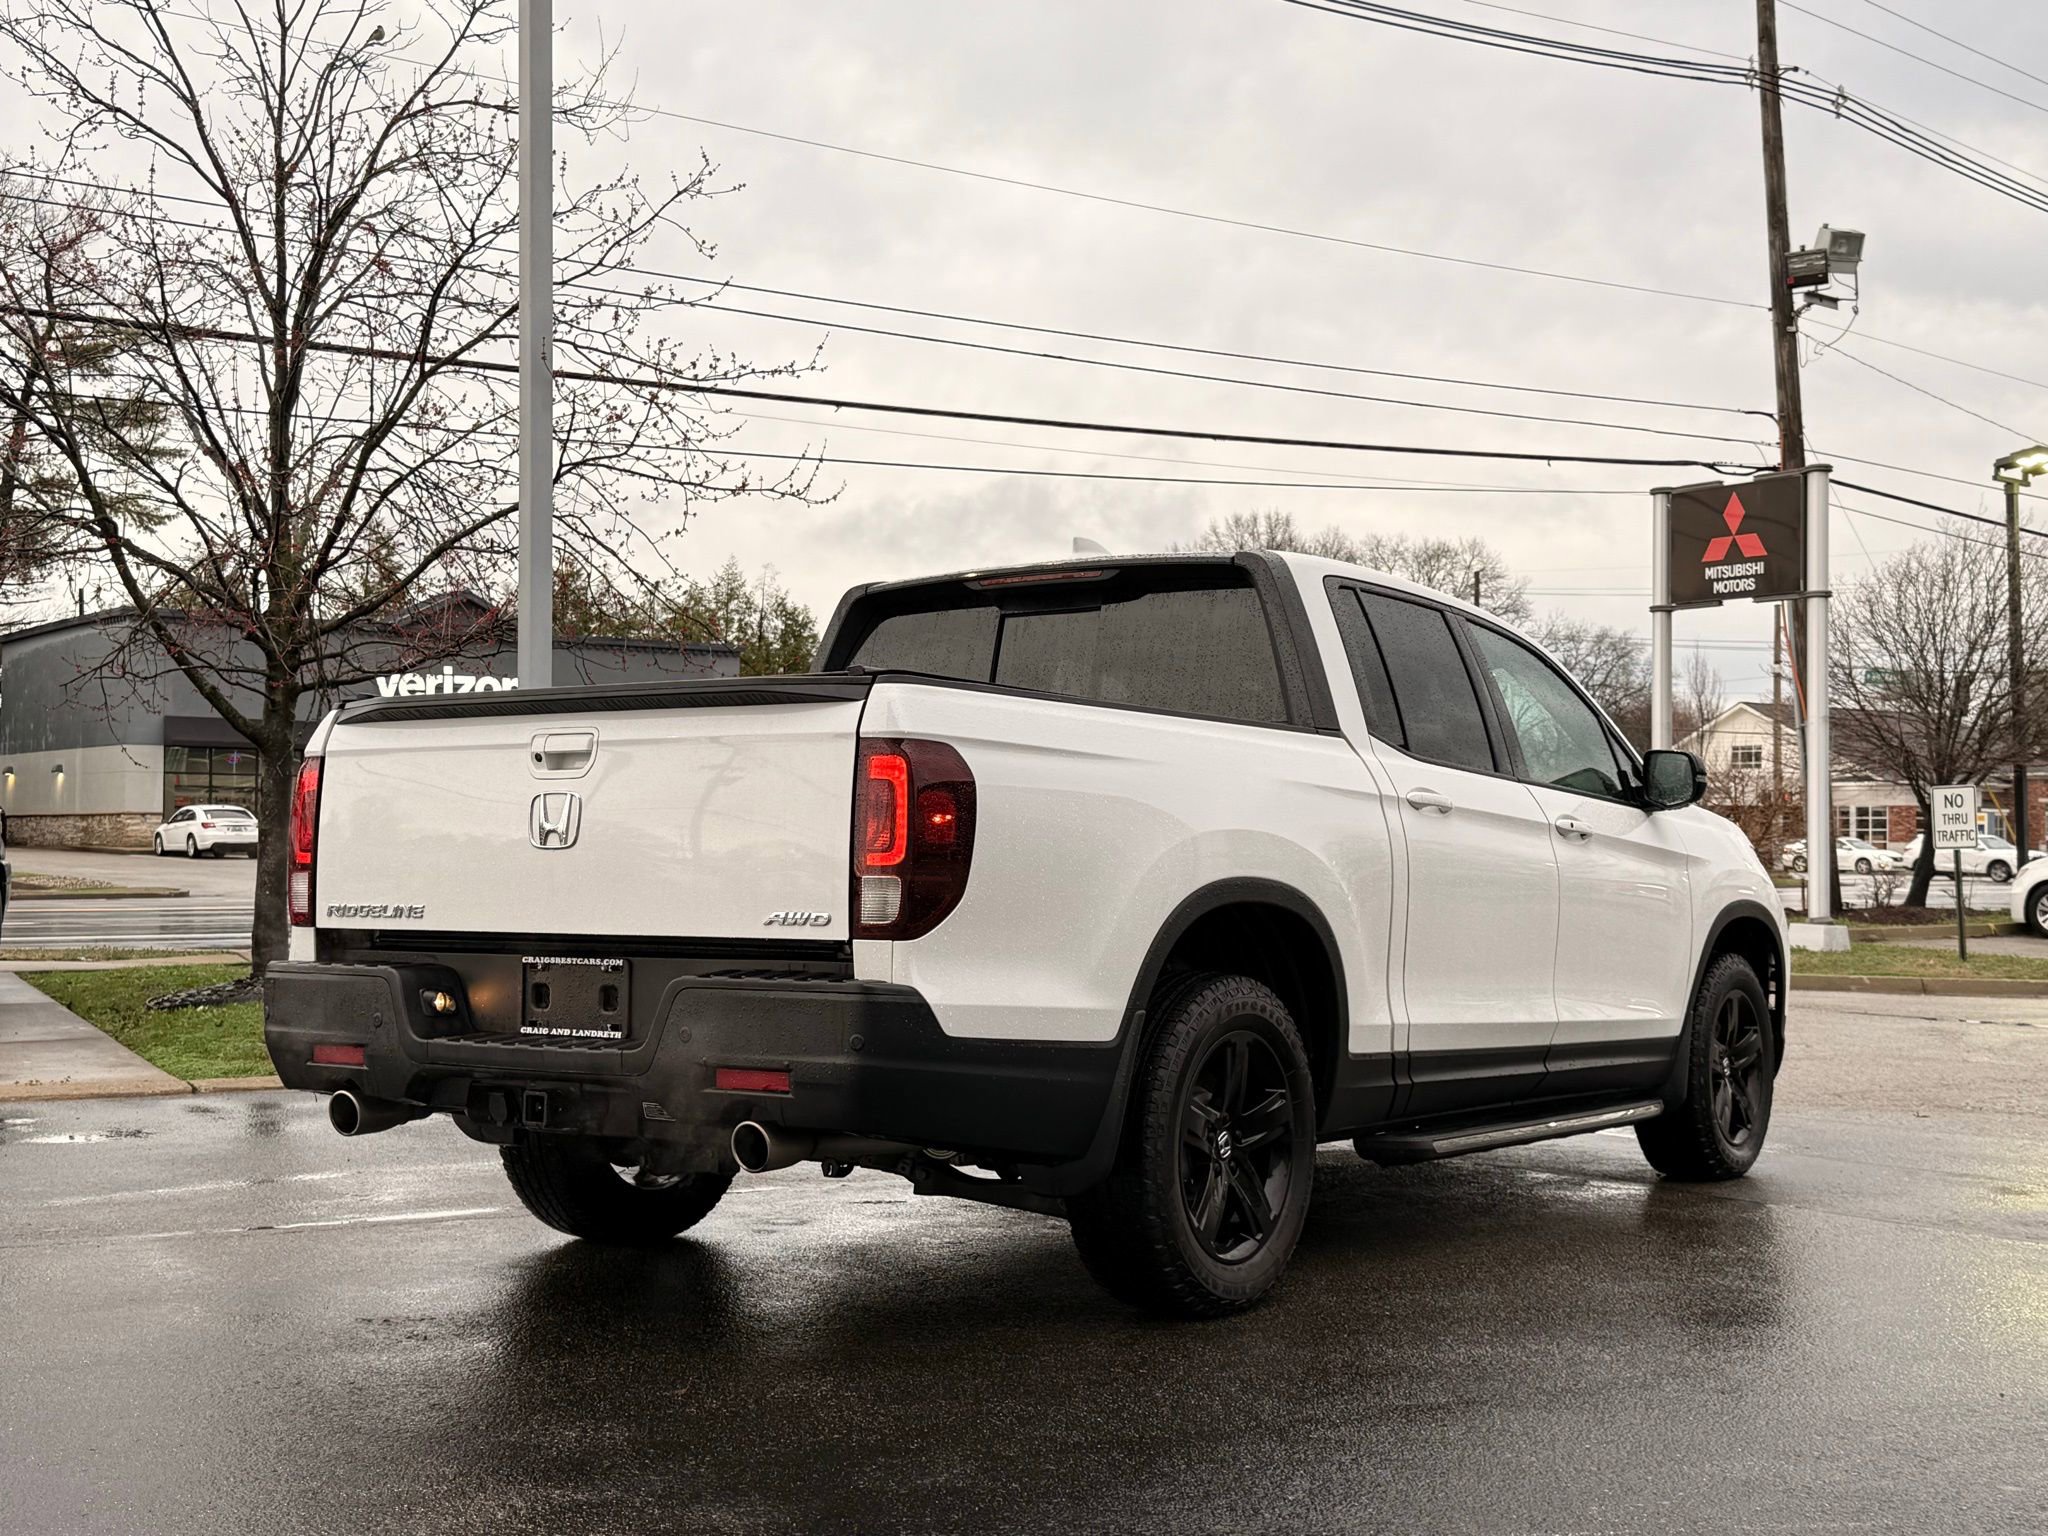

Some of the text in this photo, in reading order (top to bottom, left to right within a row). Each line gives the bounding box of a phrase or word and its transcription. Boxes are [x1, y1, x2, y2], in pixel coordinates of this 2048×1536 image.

[1704, 561, 1765, 580] MITSUBISHI
[1712, 577, 1756, 594] MOTORS
[1943, 793, 1965, 809] NO
[1942, 812, 1969, 826] THRU
[1936, 828, 1975, 843] TRAFFIC
[326, 903, 426, 920] RIDGELINE
[762, 911, 833, 927] AWD
[521, 956, 624, 967] CRAIGSBESTCARS.COM
[520, 1026, 622, 1039] CRAIG AND LANDRETH
